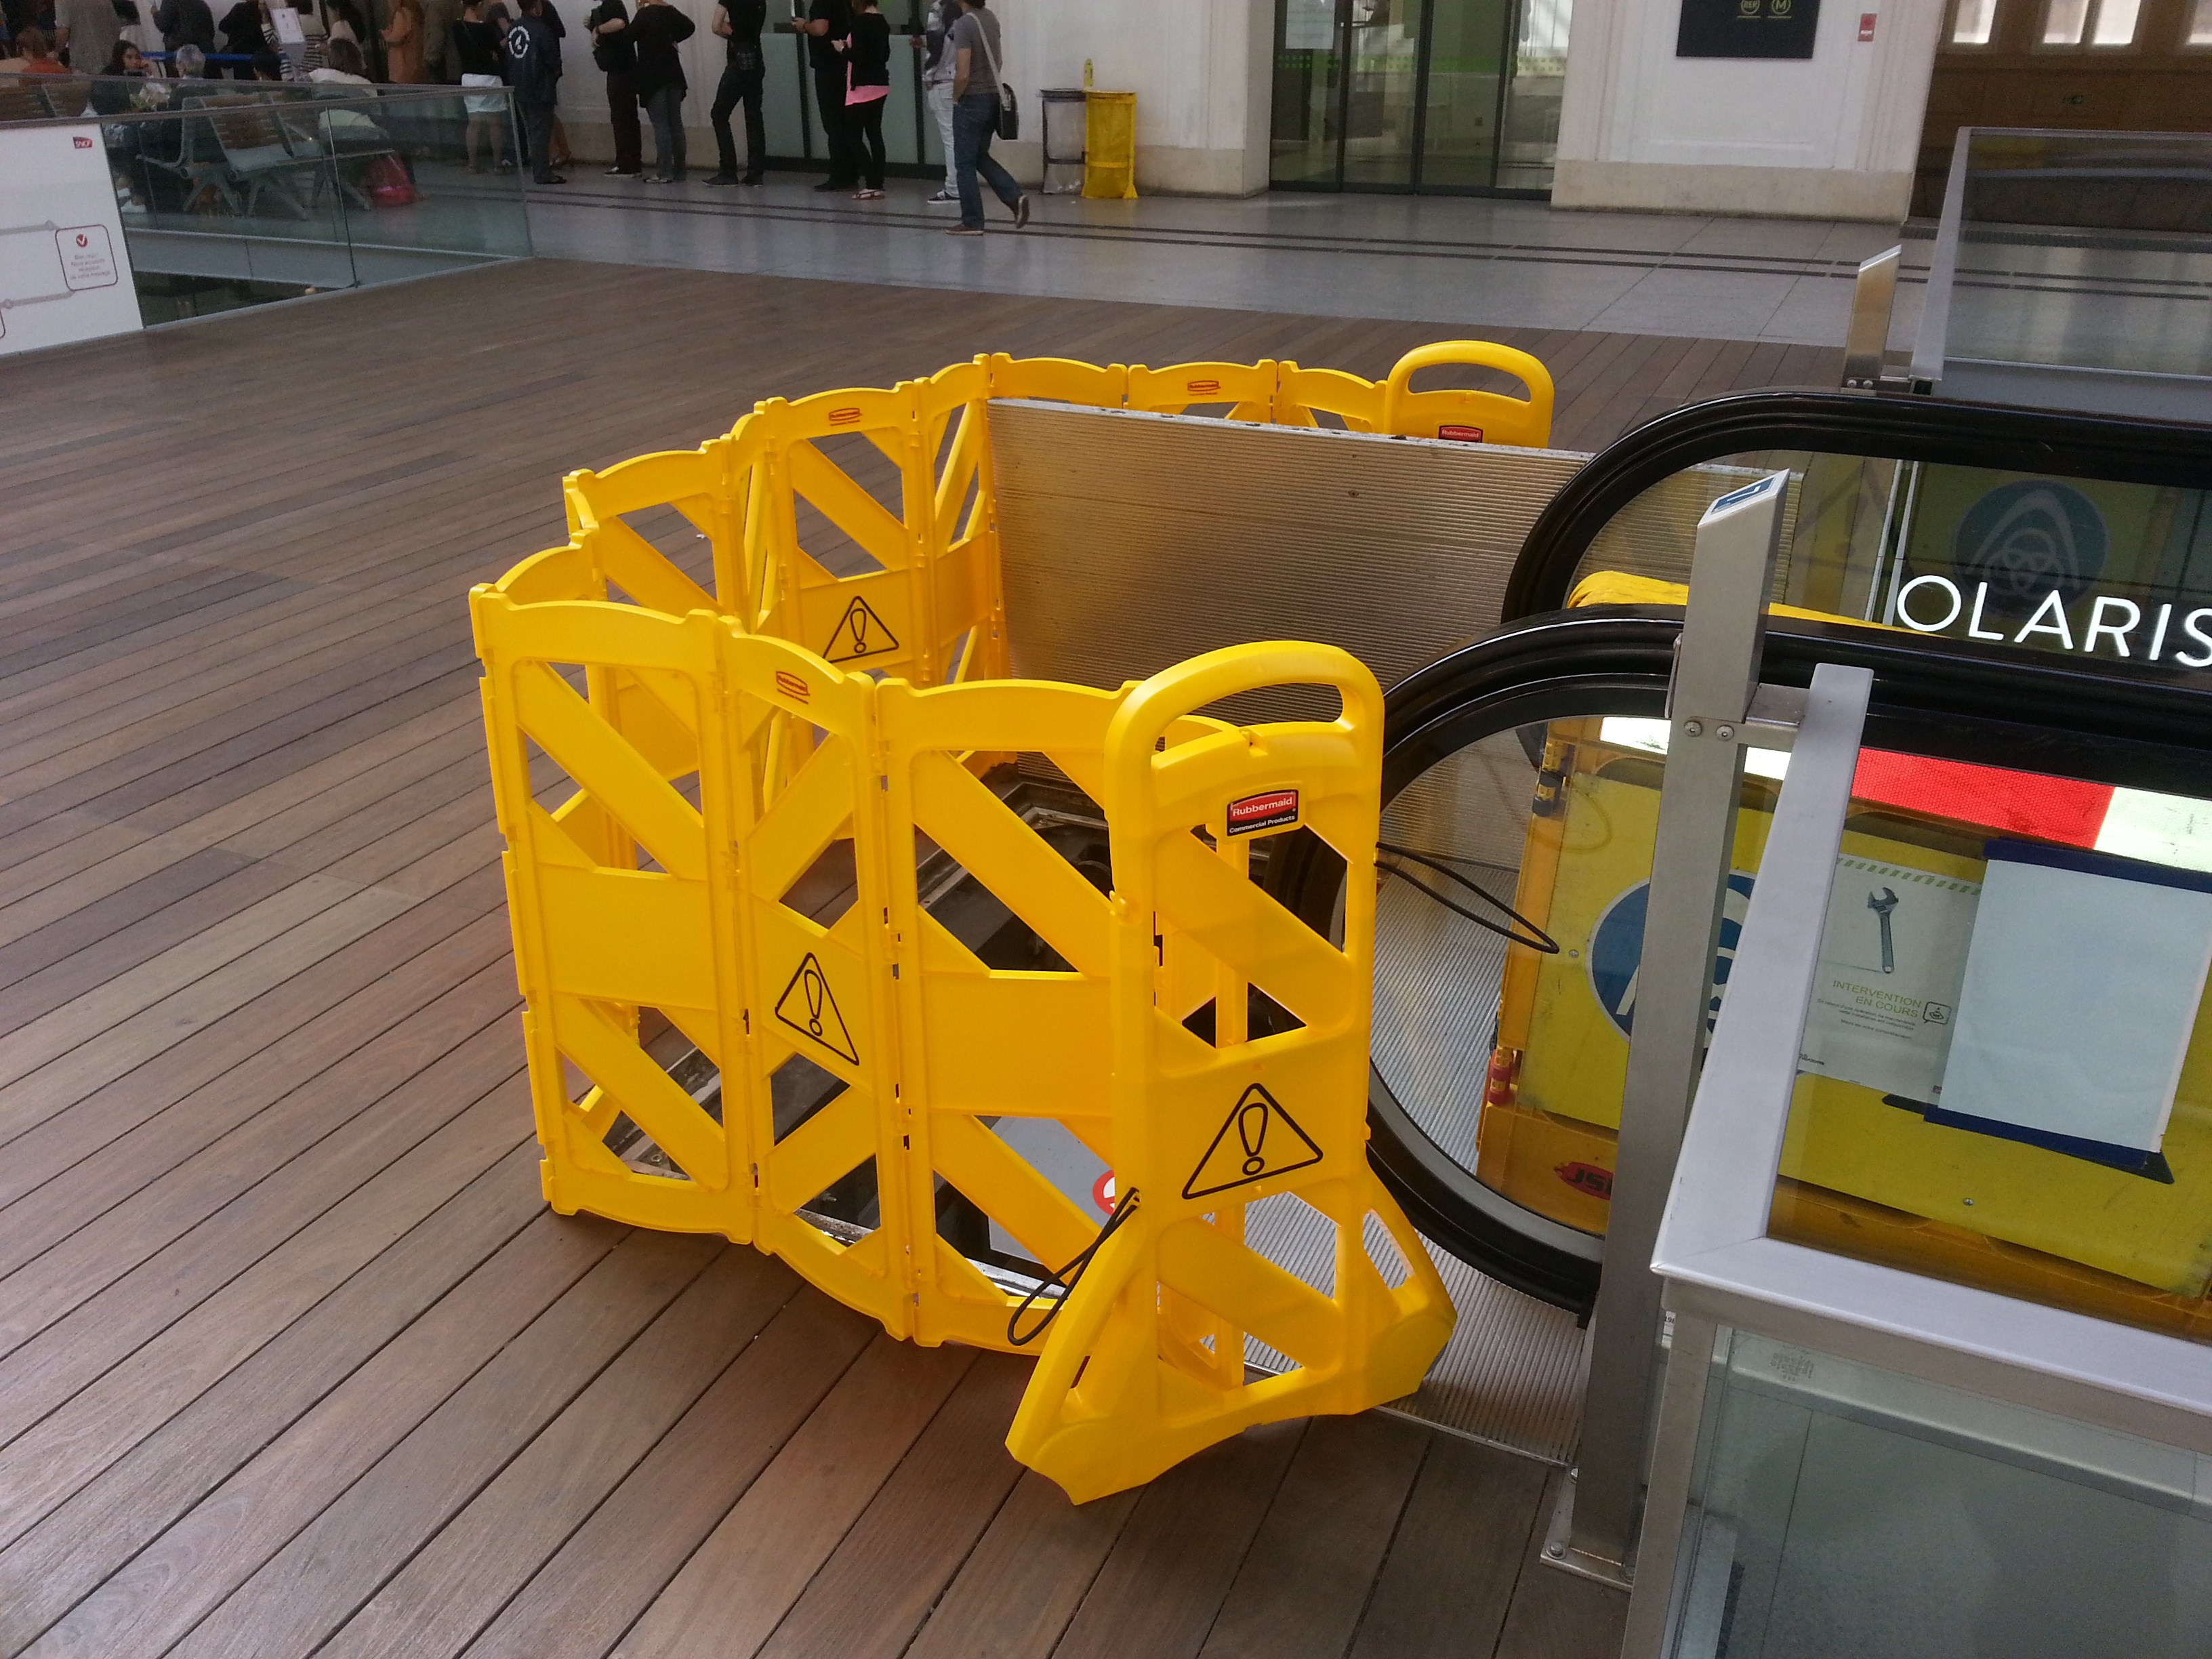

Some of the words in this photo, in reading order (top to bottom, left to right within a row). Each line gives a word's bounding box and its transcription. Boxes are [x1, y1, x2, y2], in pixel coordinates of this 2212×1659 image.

[1898, 575, 2212, 667] OLARIS
[1233, 797, 1293, 816] Rubbermaid
[1229, 821, 1267, 834] Commercial
[1267, 815, 1295, 825] Products
[1832, 979, 1922, 1008] INTERVENTION
[1856, 996, 1872, 1006] EN
[1875, 1001, 1919, 1018] COURS
